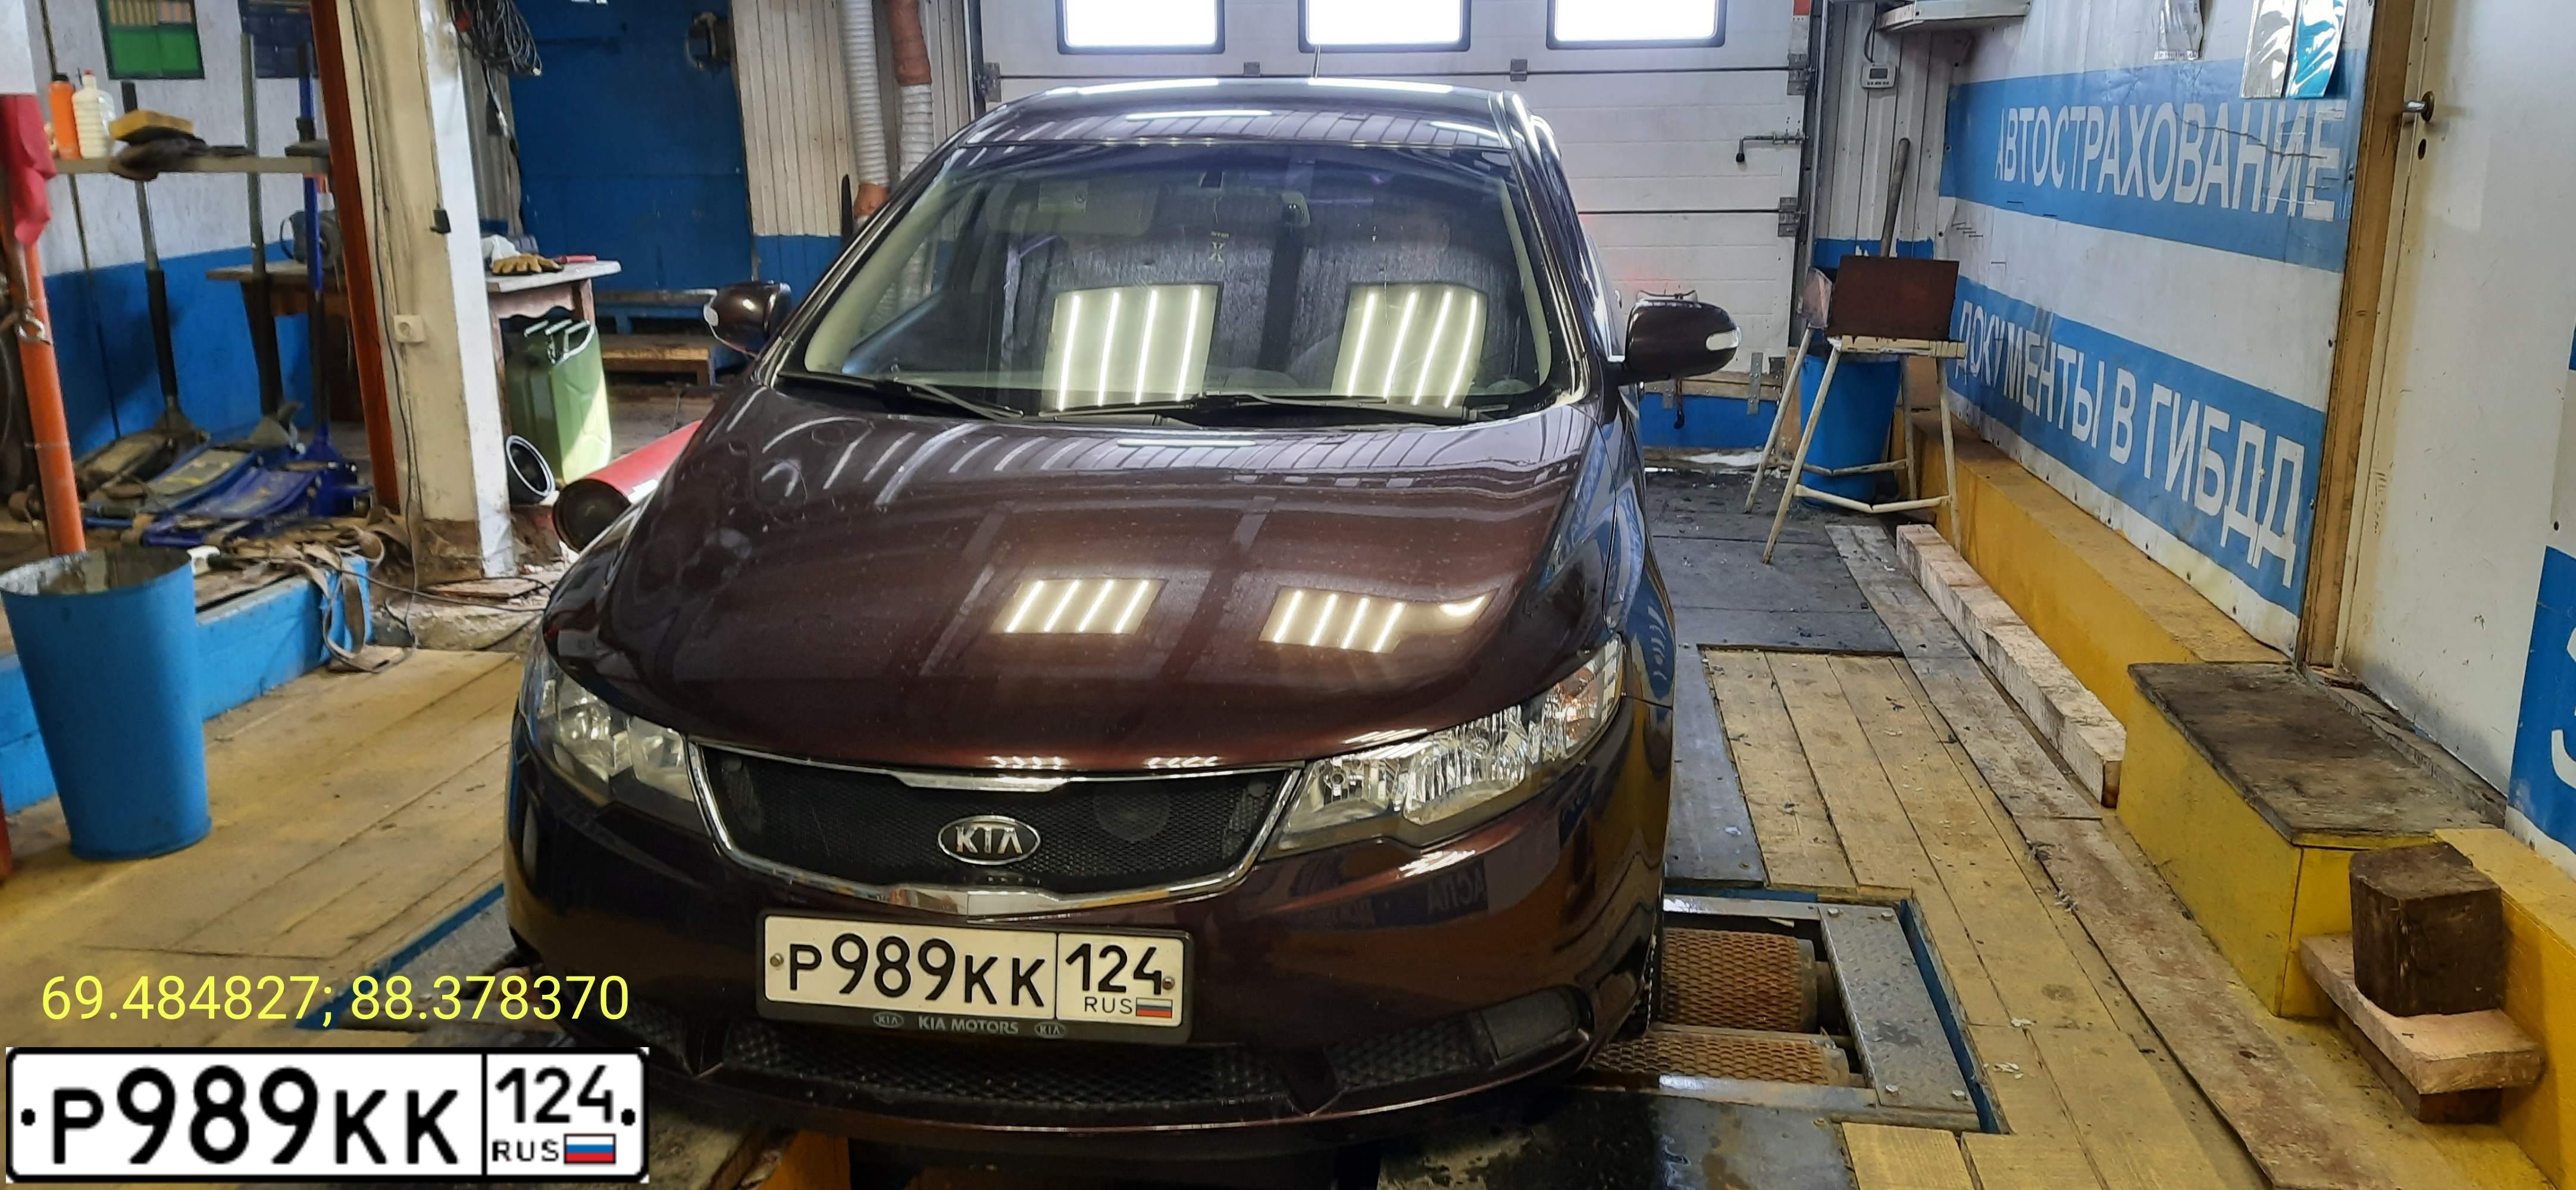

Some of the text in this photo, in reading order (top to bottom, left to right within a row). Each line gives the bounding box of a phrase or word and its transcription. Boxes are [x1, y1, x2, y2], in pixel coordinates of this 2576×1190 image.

[1995, 99, 2347, 221] АВТОСТРАХОВАНИЕ
[1954, 300, 2305, 588] ДОКУМЕНТЫ В ГИБДД
[955, 826, 1023, 854] KIA
[1065, 942, 1162, 995] 124
[918, 1015, 946, 1031] KIA
[951, 1018, 1019, 1035] MOTORS
[1084, 996, 1133, 1014] RUS
